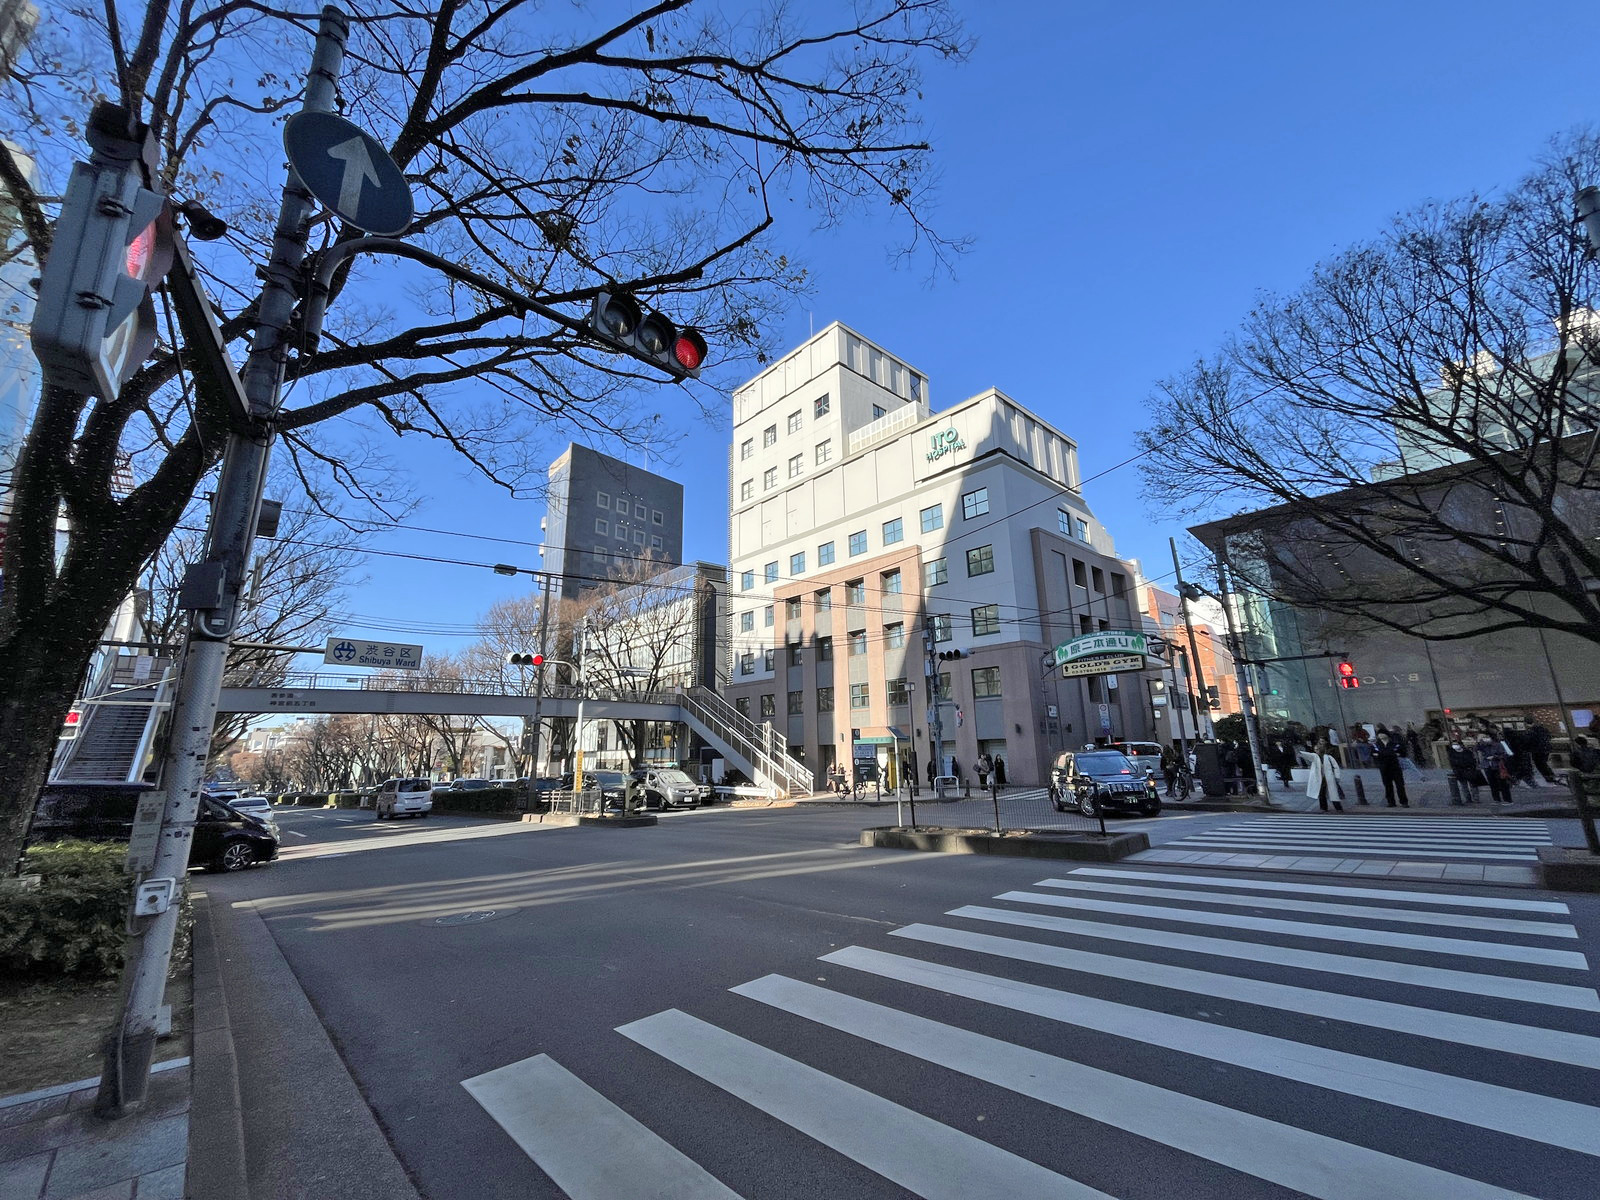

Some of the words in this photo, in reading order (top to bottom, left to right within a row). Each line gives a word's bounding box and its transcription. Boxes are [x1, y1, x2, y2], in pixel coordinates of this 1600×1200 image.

[931, 427, 958, 450] ITO
[926, 439, 967, 463] HOSPITAL
[365, 644, 412, 658] 渋谷区
[359, 655, 391, 666] Shibuya
[395, 658, 416, 667] Ward
[1071, 660, 1110, 668] GOLD'S
[1113, 657, 1140, 665] GYM
[1077, 655, 1104, 663] FITNESS
